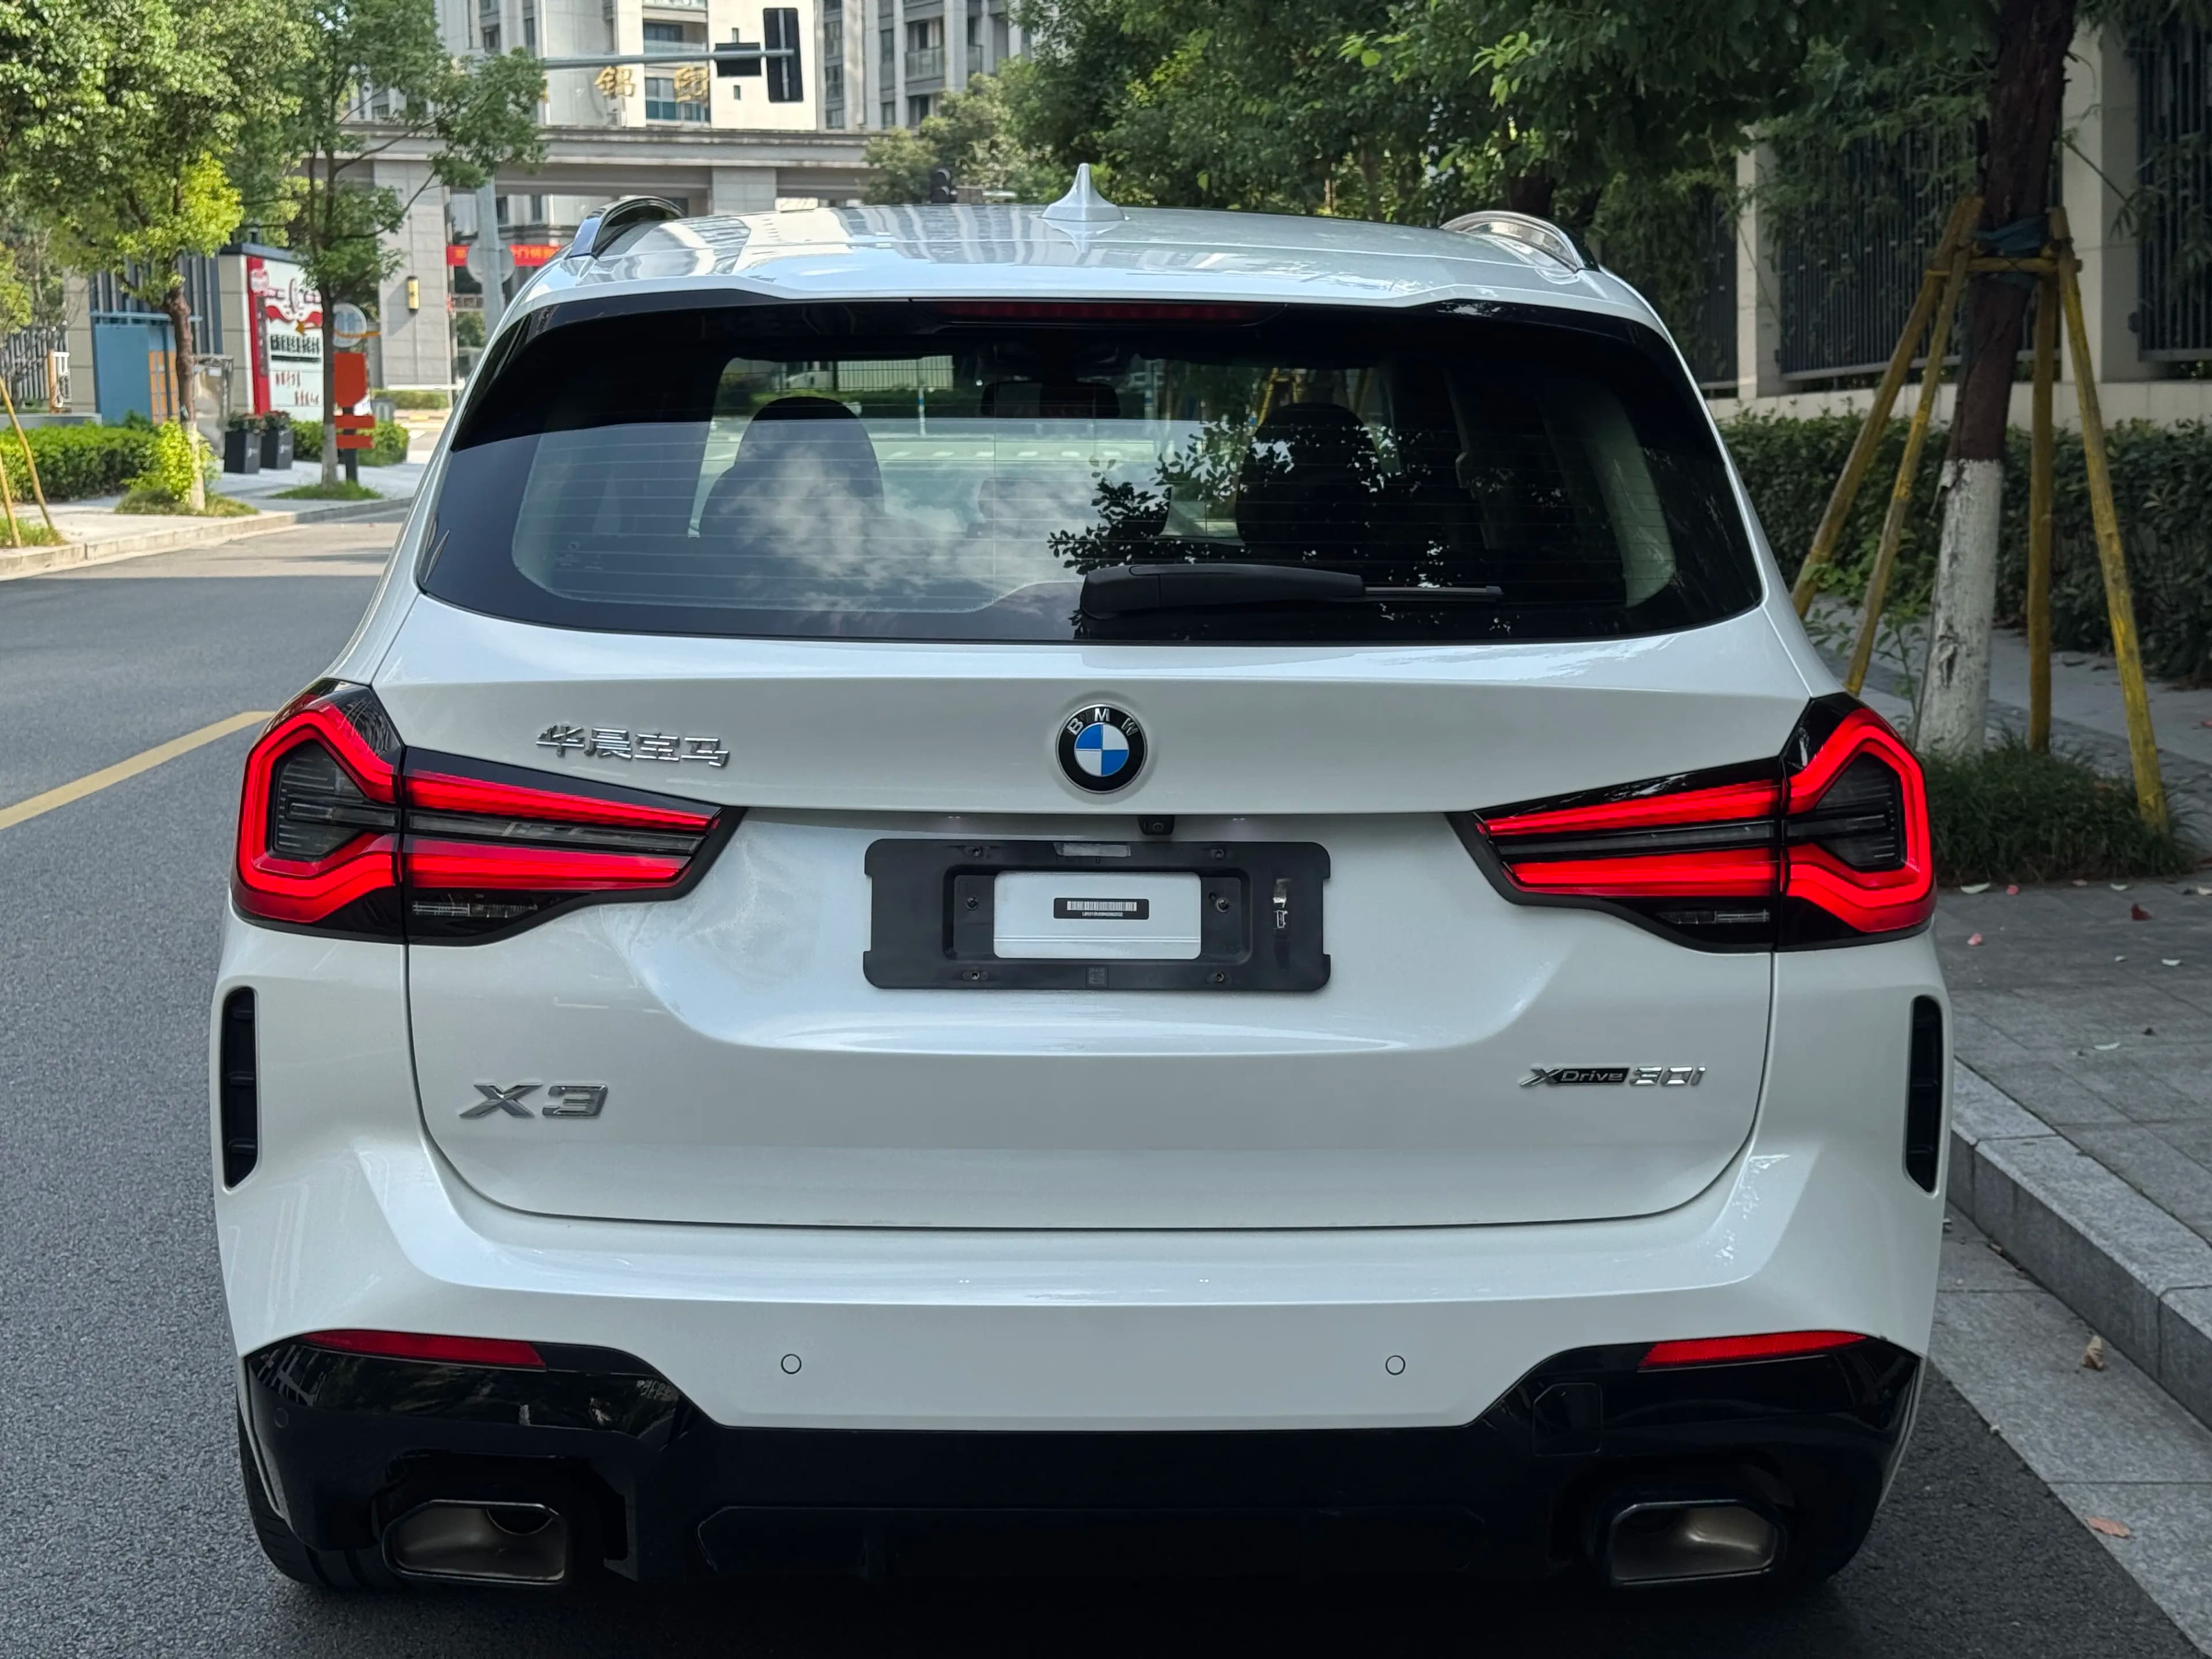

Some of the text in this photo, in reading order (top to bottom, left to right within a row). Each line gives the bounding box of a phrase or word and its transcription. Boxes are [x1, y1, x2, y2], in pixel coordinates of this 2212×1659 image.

[1067, 707, 1139, 737] BMW
[535, 724, 730, 769] 华晨宝马
[459, 1083, 608, 1119] X3
